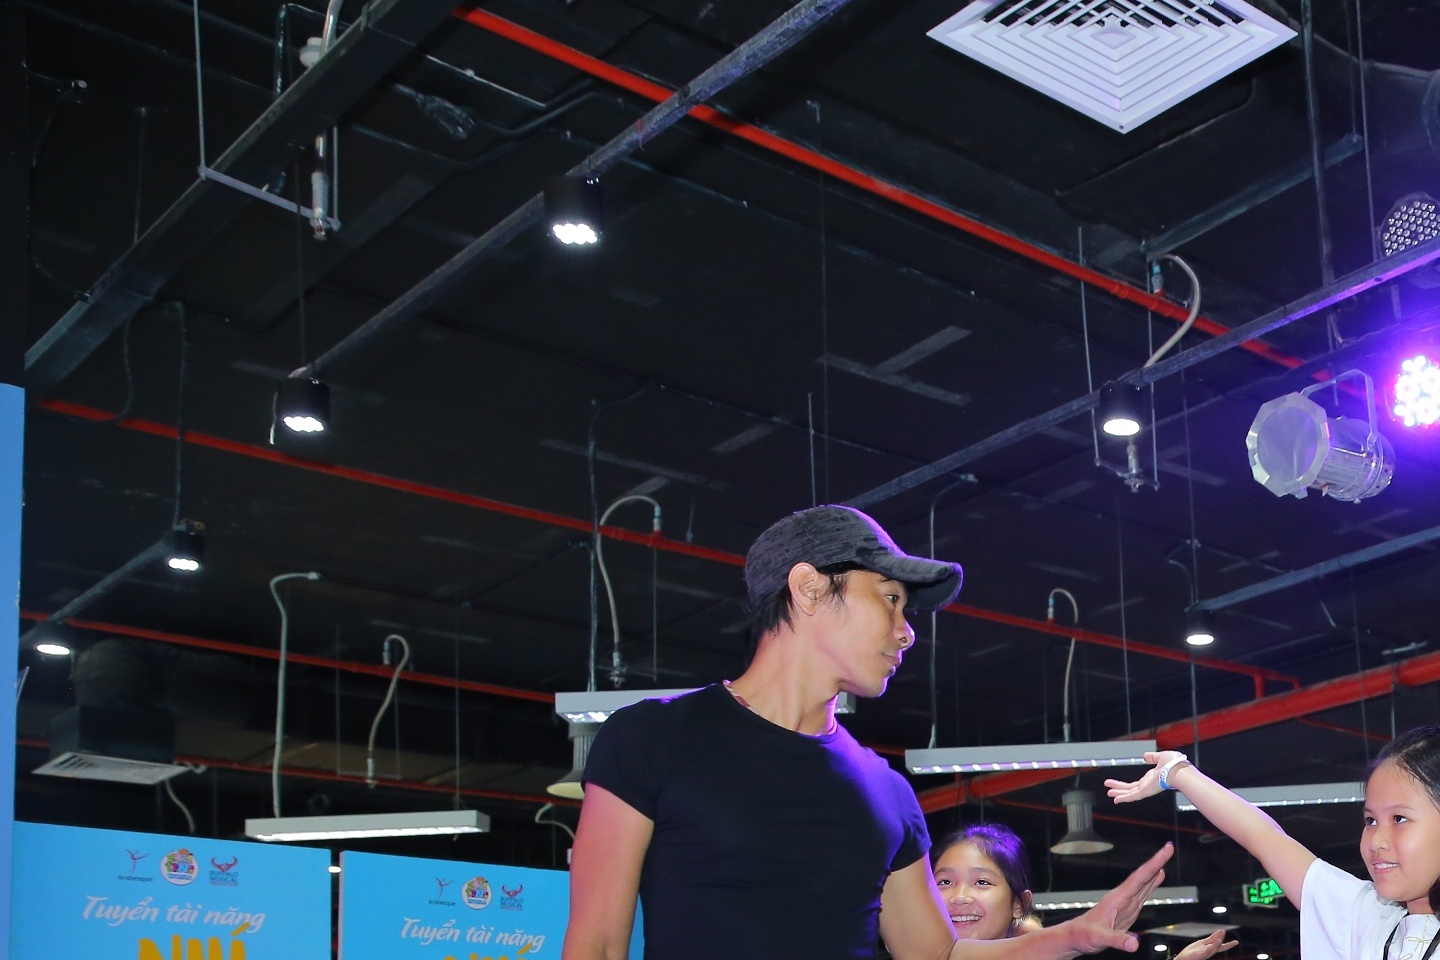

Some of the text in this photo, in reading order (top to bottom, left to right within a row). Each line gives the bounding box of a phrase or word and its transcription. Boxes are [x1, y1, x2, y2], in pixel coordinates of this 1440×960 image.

[83, 895, 266, 934] Tuyển tài năng
[401, 917, 545, 953] Tuyển tài năng
